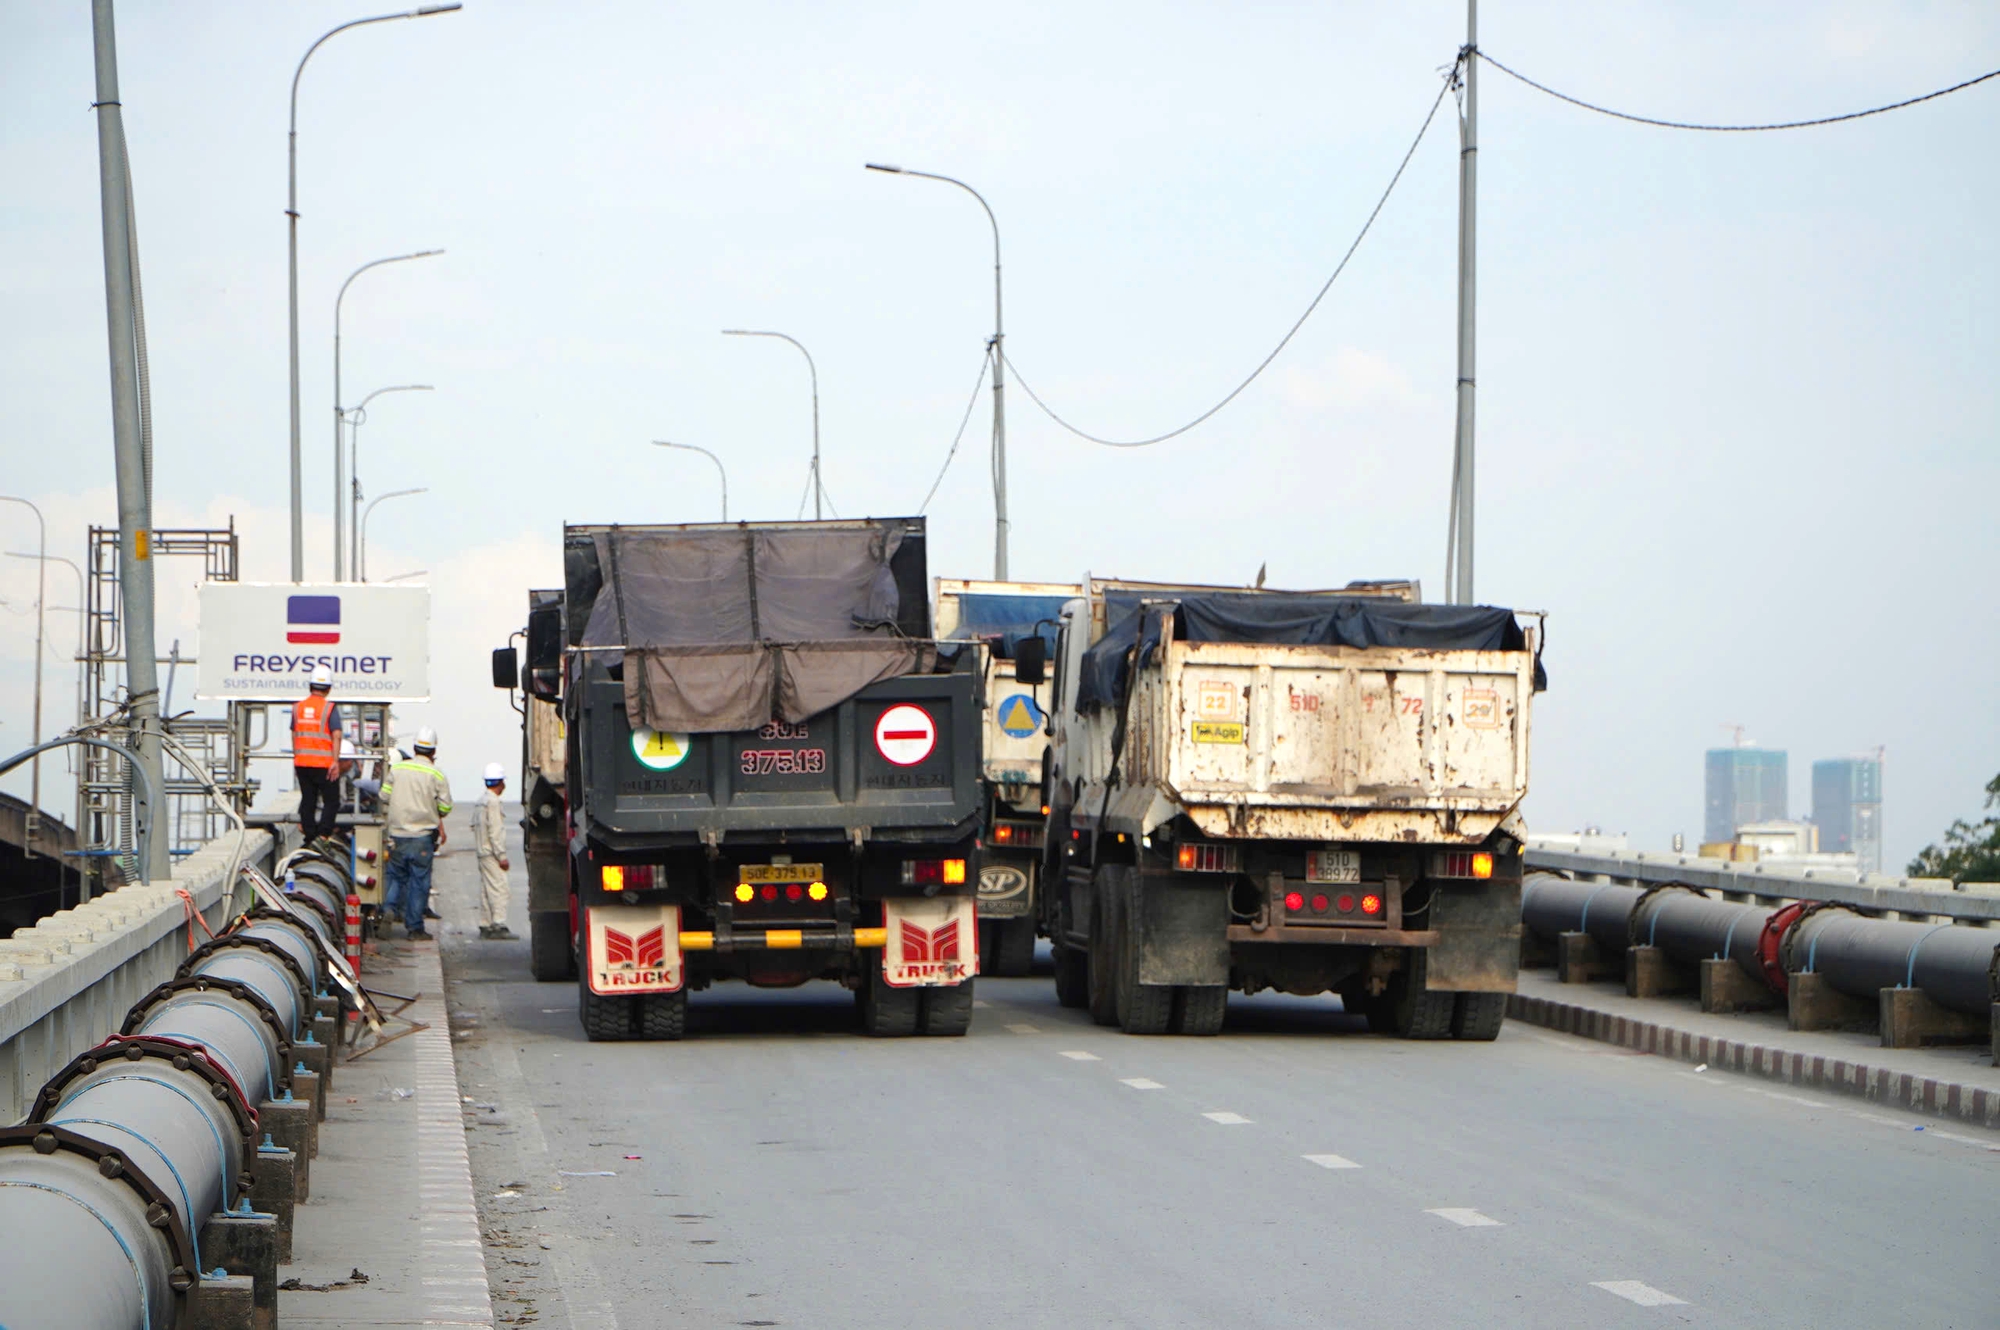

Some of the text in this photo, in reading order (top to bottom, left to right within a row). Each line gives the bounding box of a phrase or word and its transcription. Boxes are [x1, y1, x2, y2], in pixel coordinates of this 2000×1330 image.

[1205, 695, 1226, 709] 22
[741, 748, 825, 775] 375.13
[600, 970, 672, 986] TRUCK
